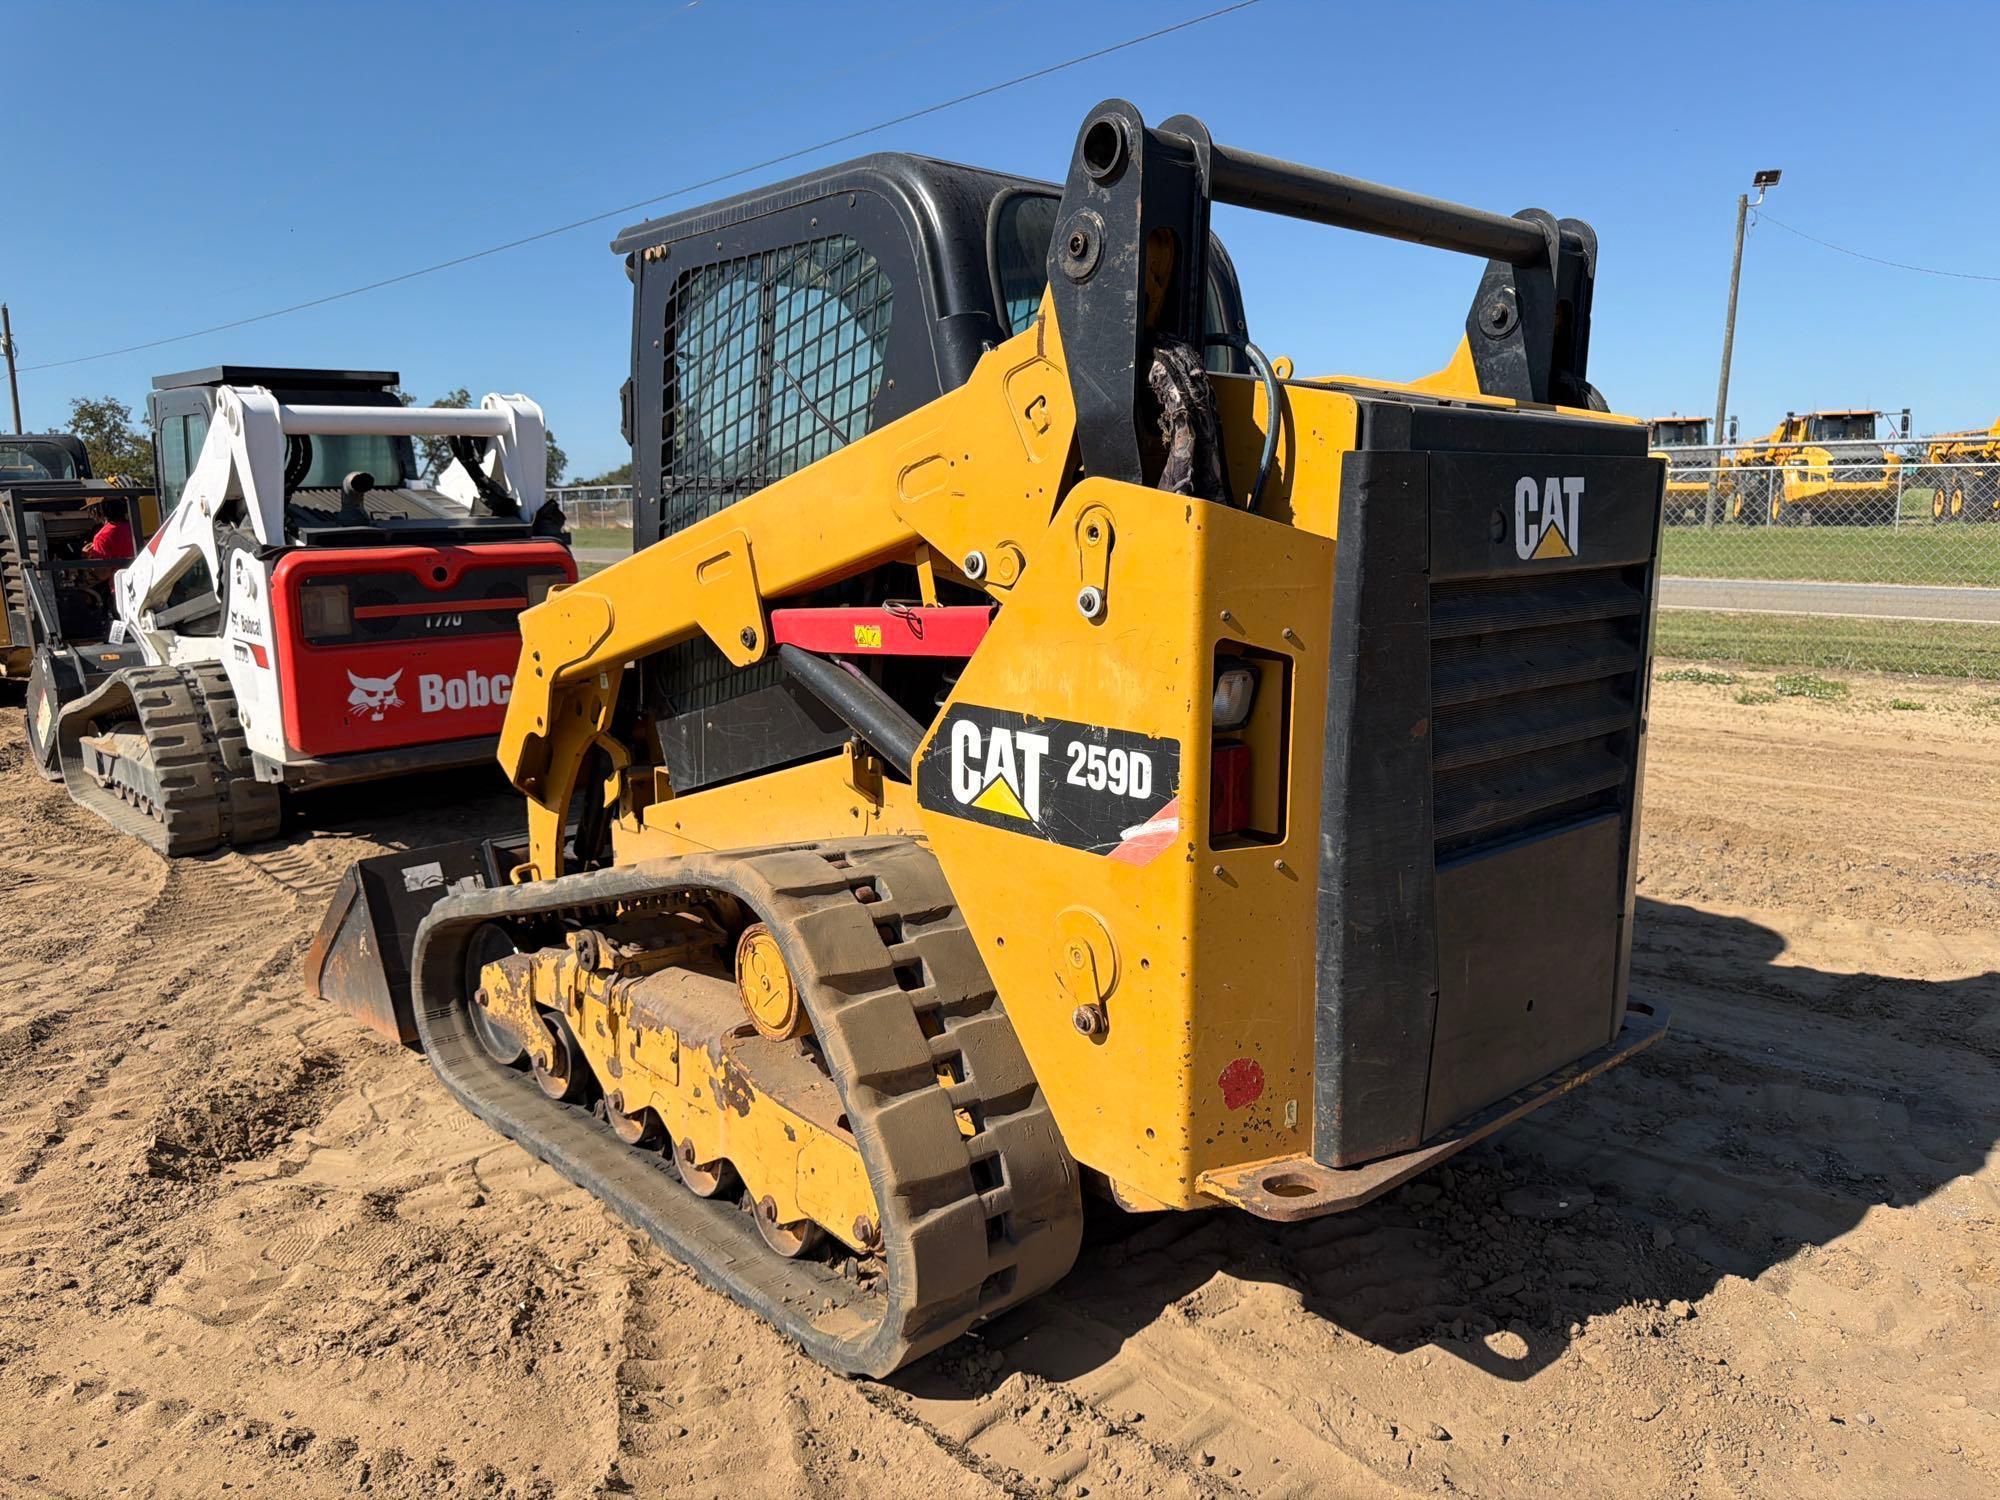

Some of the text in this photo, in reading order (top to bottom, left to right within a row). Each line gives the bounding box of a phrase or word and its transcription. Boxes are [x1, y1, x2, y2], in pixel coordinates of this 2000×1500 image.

[1514, 476, 1585, 561] CAT
[419, 670, 516, 713] Bobc
[951, 719, 1152, 822] CAT 259D
